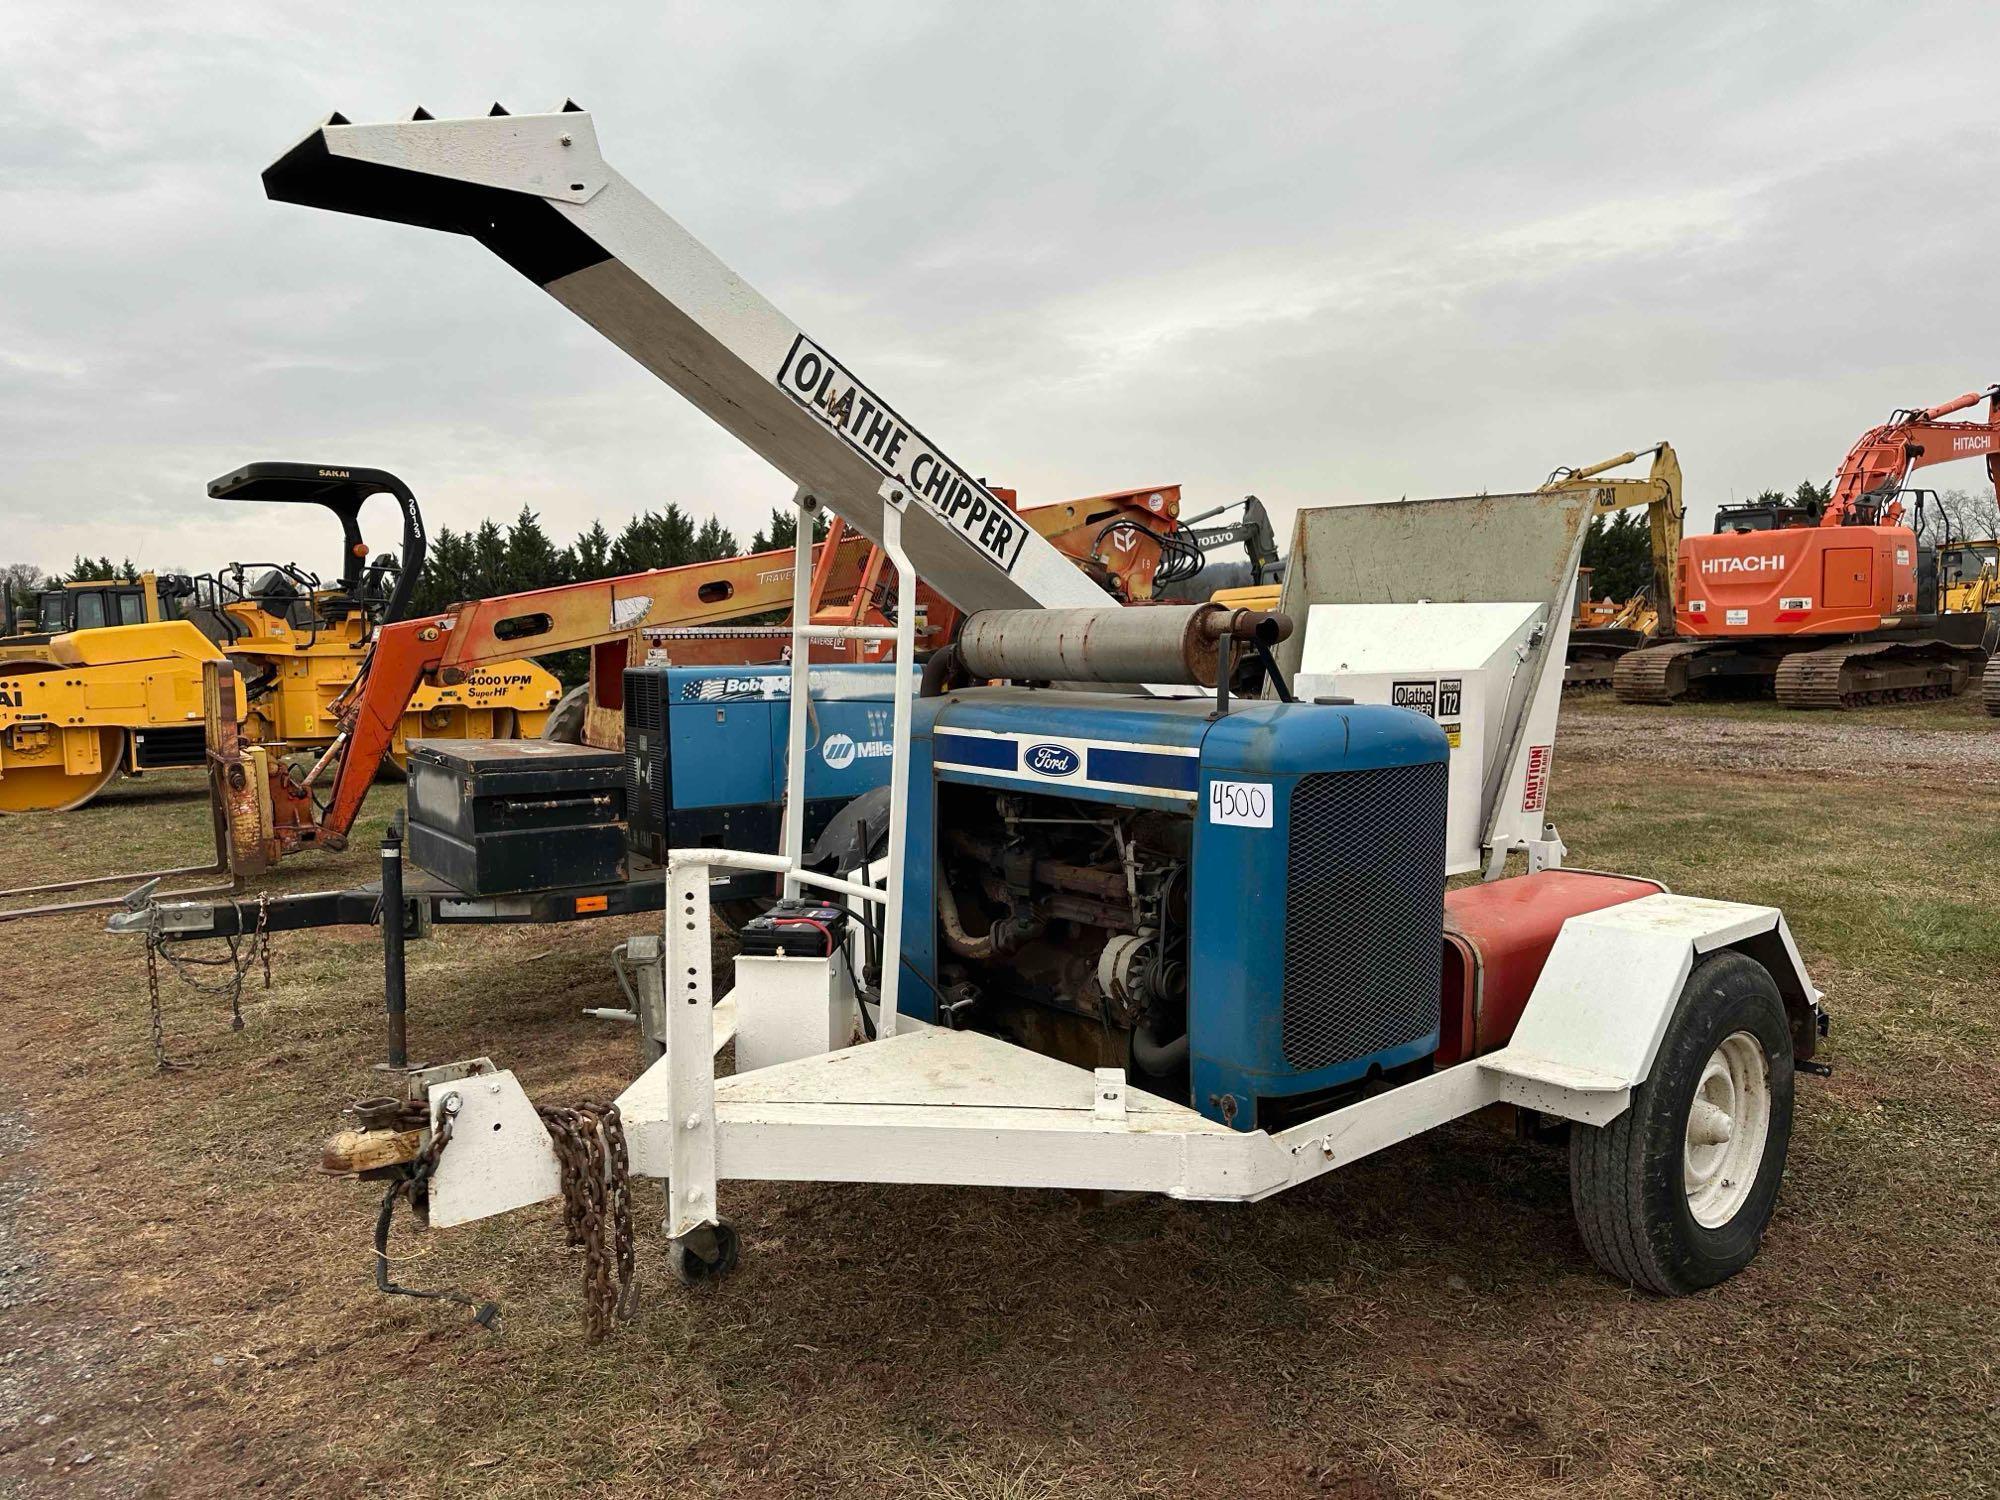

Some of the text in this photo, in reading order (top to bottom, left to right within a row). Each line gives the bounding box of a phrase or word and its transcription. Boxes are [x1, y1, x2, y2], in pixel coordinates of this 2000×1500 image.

[1953, 436, 1991, 450] HITACHI
[794, 352, 1013, 559] OLATHE CHIPPER
[319, 469, 350, 478] SAKAI
[1599, 487, 1616, 506] CAT
[408, 499, 421, 539] 20123
[1702, 555, 1785, 574] HITACHI
[503, 675, 532, 685] VPM
[468, 687, 494, 699] Super
[1396, 683, 1459, 703] Olathe Model
[1442, 693, 1458, 714] 172
[857, 741, 894, 758] Mille
[1034, 747, 1069, 772] Ford
[1525, 749, 1543, 810] CAUTION
[1212, 784, 1266, 818] 4500
